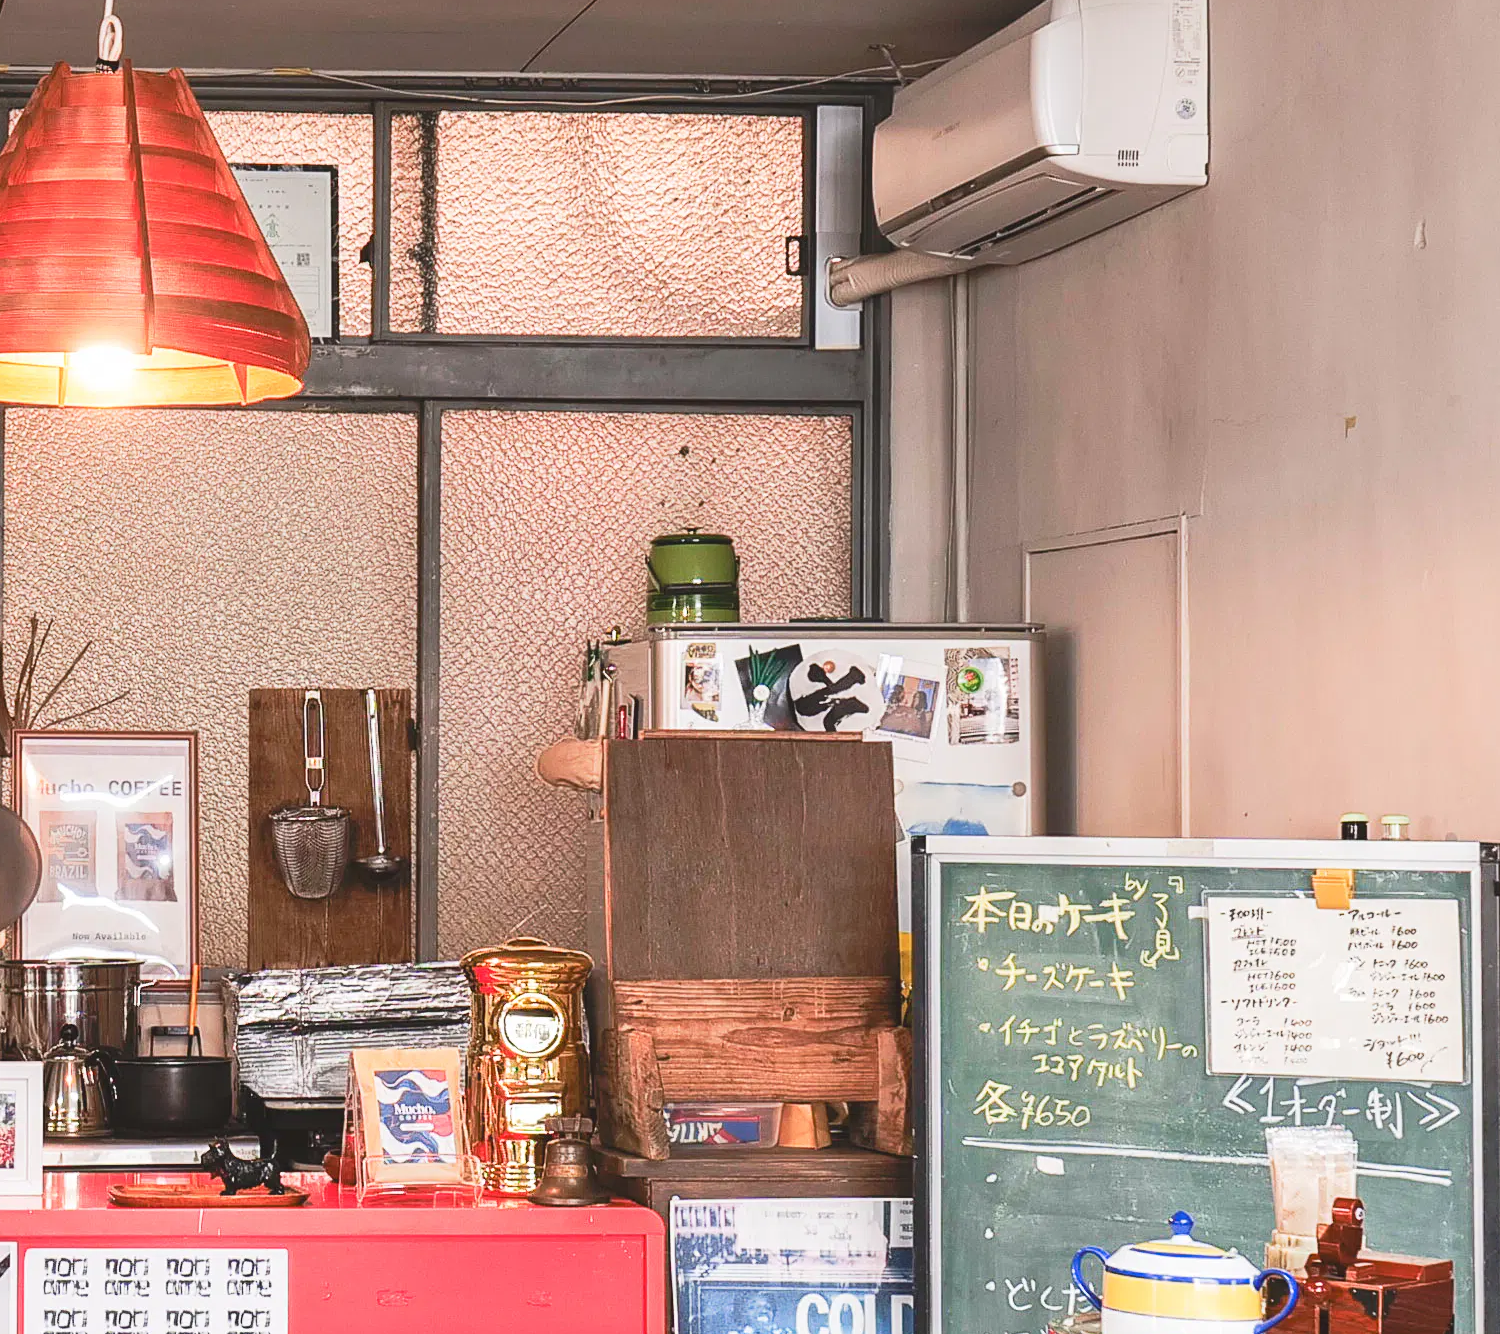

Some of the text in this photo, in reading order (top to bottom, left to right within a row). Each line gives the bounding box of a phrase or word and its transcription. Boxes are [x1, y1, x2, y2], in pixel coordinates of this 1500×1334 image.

[49, 865, 88, 880] BRAZIL
[962, 873, 1148, 940] 本日のケーキ by
[72, 932, 146, 941] Now Available
[515, 1021, 551, 1041] 郵便
[1005, 1278, 1100, 1315] どくだ
